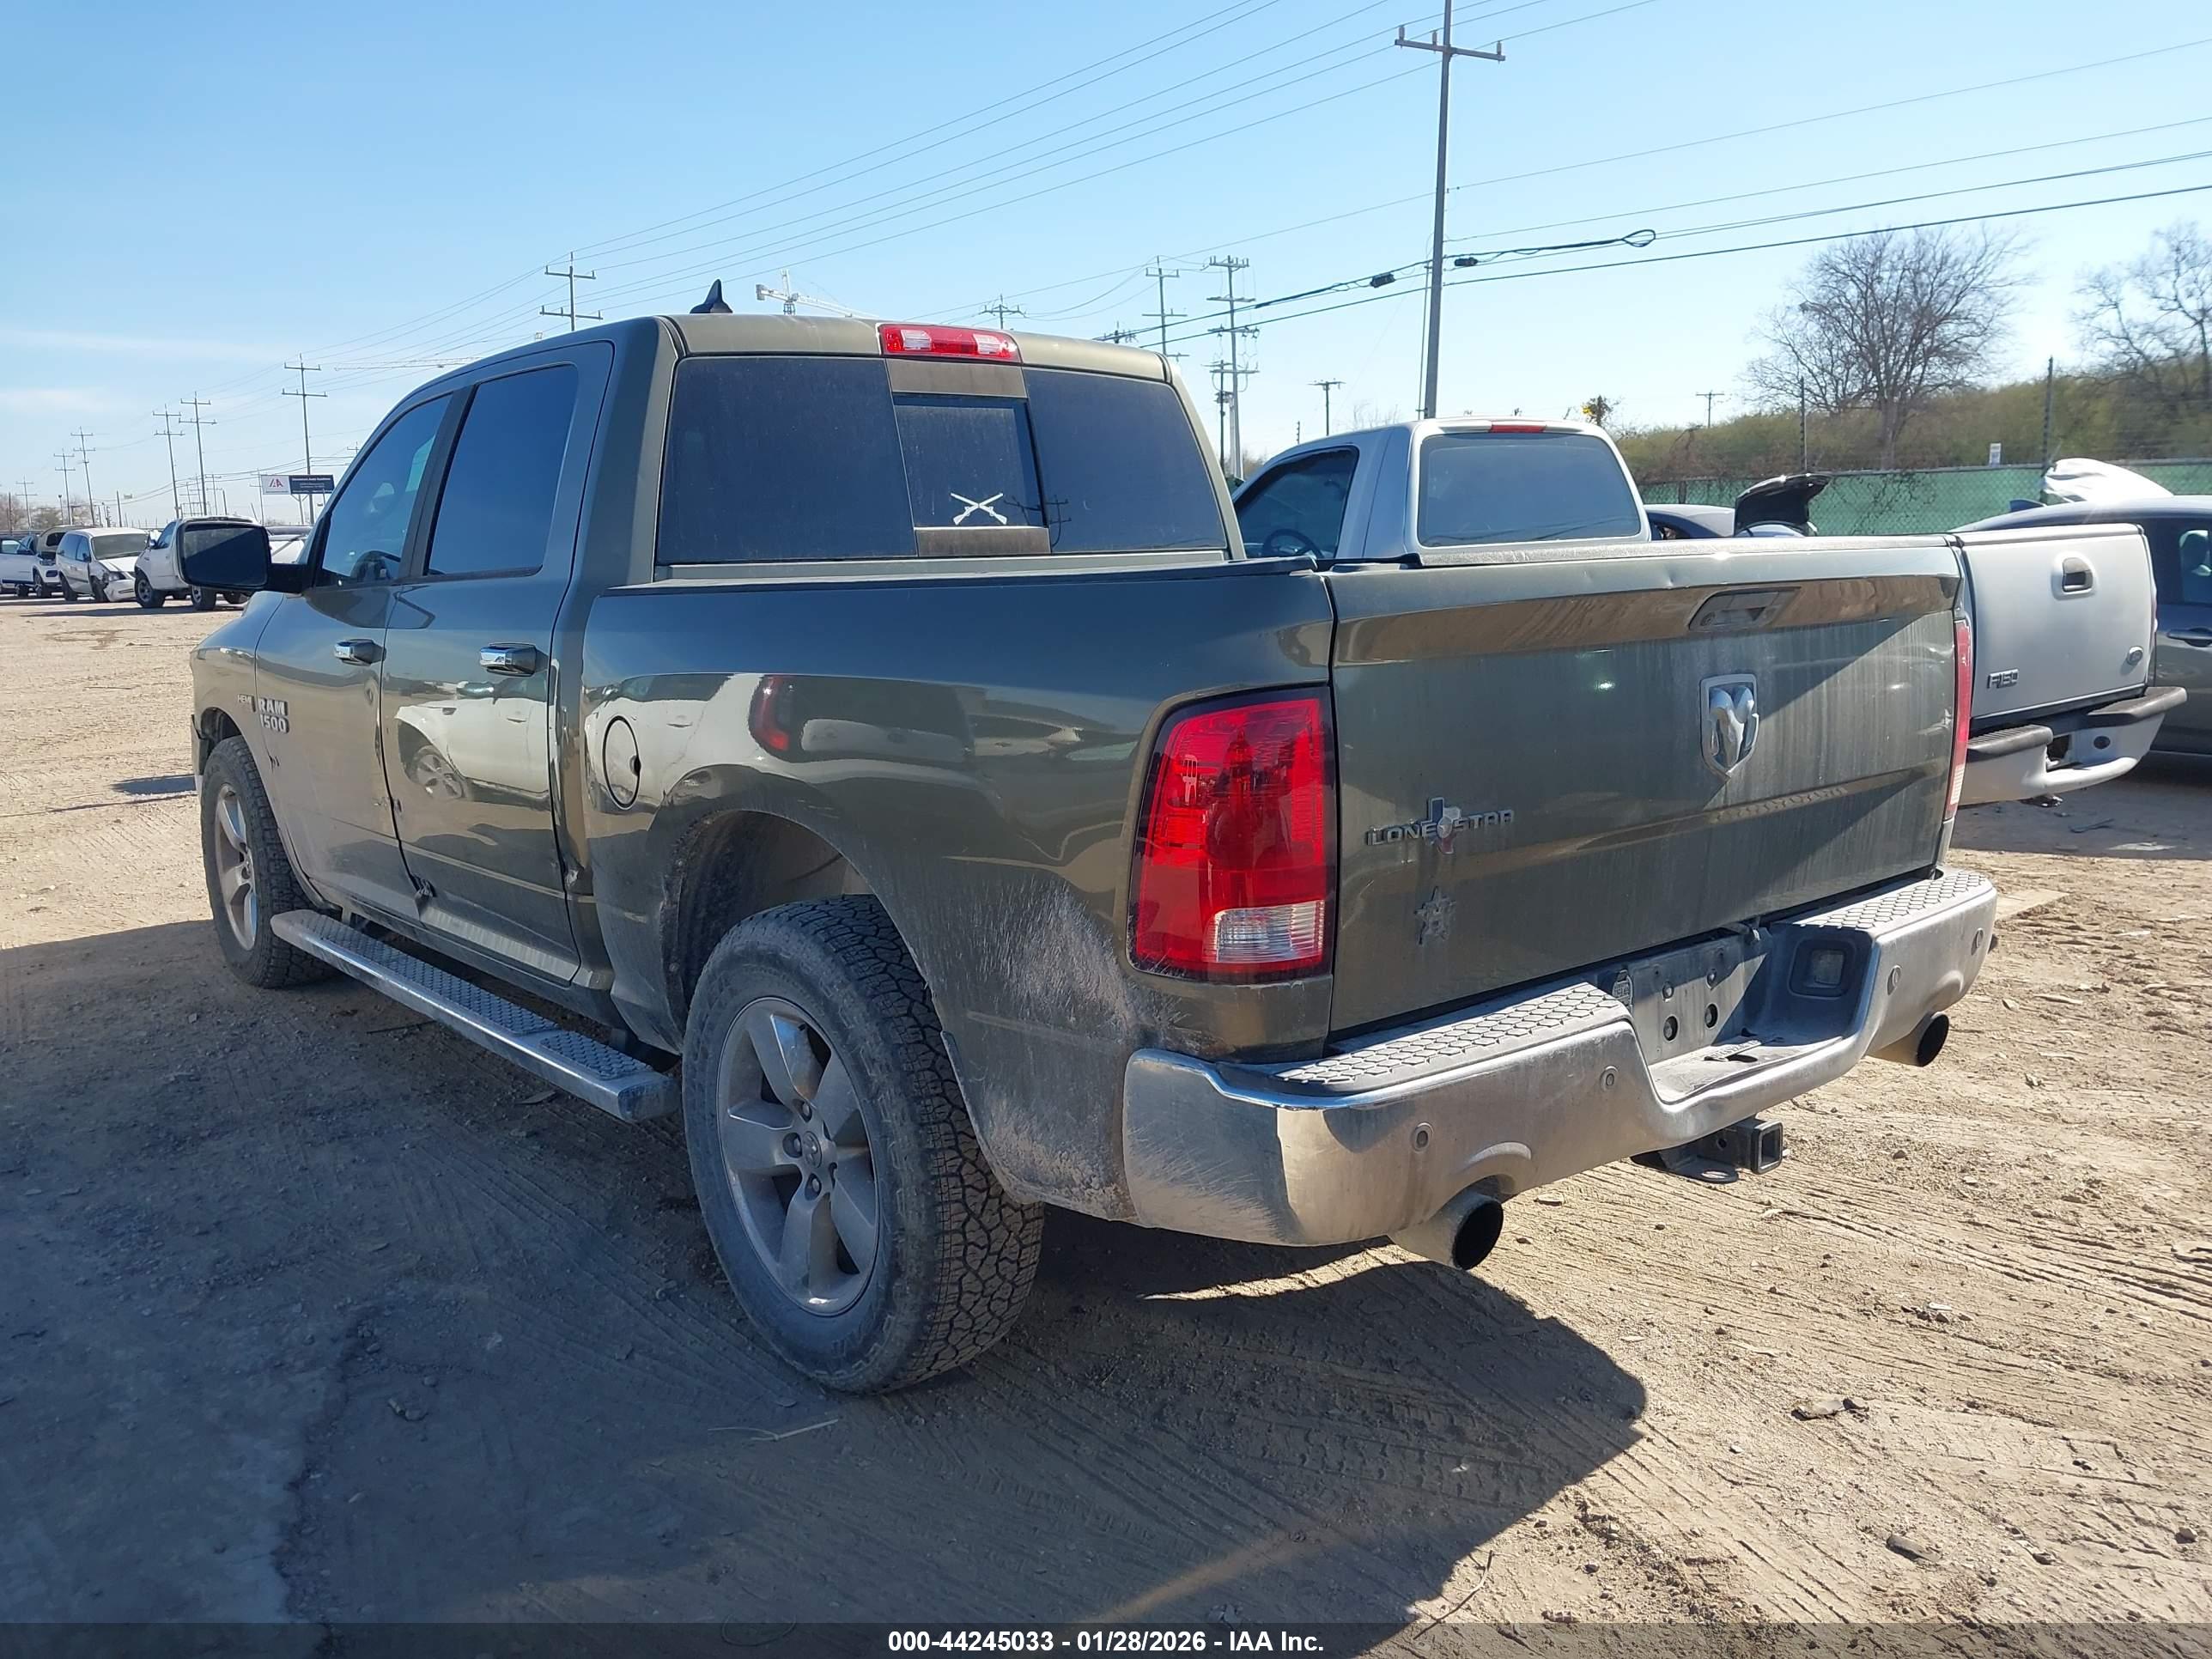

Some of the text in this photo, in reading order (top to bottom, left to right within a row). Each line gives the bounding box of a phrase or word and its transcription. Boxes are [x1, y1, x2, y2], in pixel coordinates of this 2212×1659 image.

[258, 696, 288, 716] RAM
[259, 714, 289, 733] 1500
[1366, 810, 1514, 846] LONE STAR
